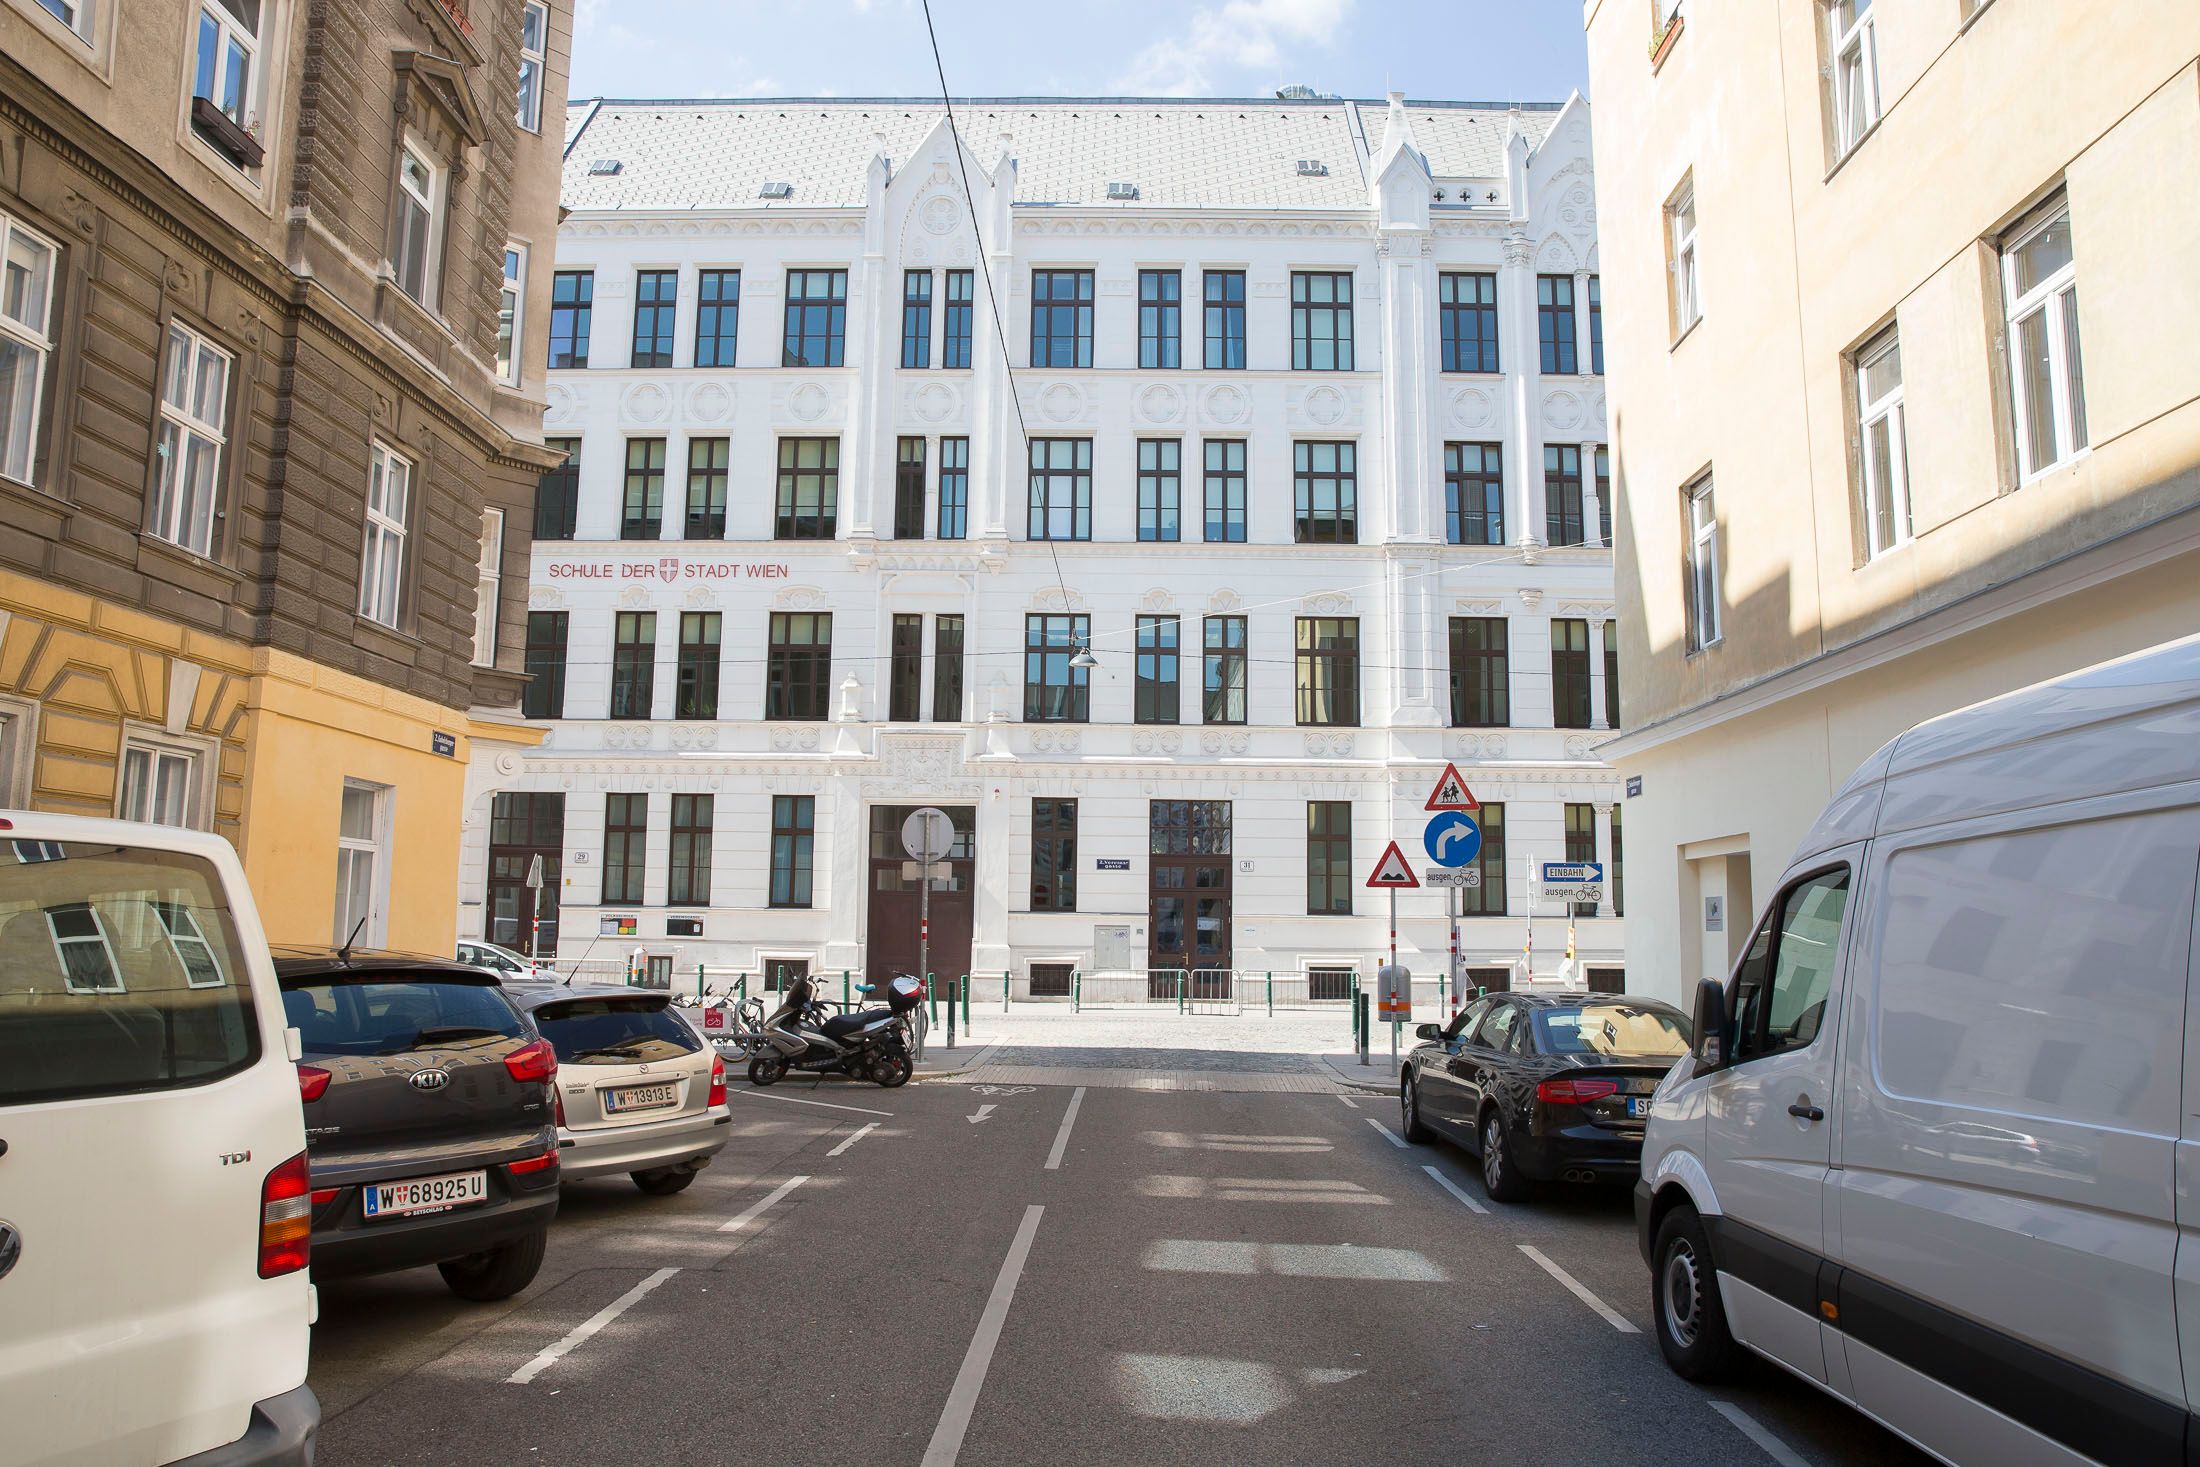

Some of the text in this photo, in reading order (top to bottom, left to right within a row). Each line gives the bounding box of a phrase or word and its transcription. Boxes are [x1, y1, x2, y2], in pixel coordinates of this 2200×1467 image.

[549, 563, 788, 578] SCHULE DER STADT WIEN
[1549, 868, 1584, 876] EINBAHN
[1426, 873, 1453, 883] ausgen.
[1545, 888, 1576, 897] ausgen.
[416, 1073, 445, 1088] KIA
[219, 1150, 252, 1166] TDI
[369, 1203, 376, 1211] A
